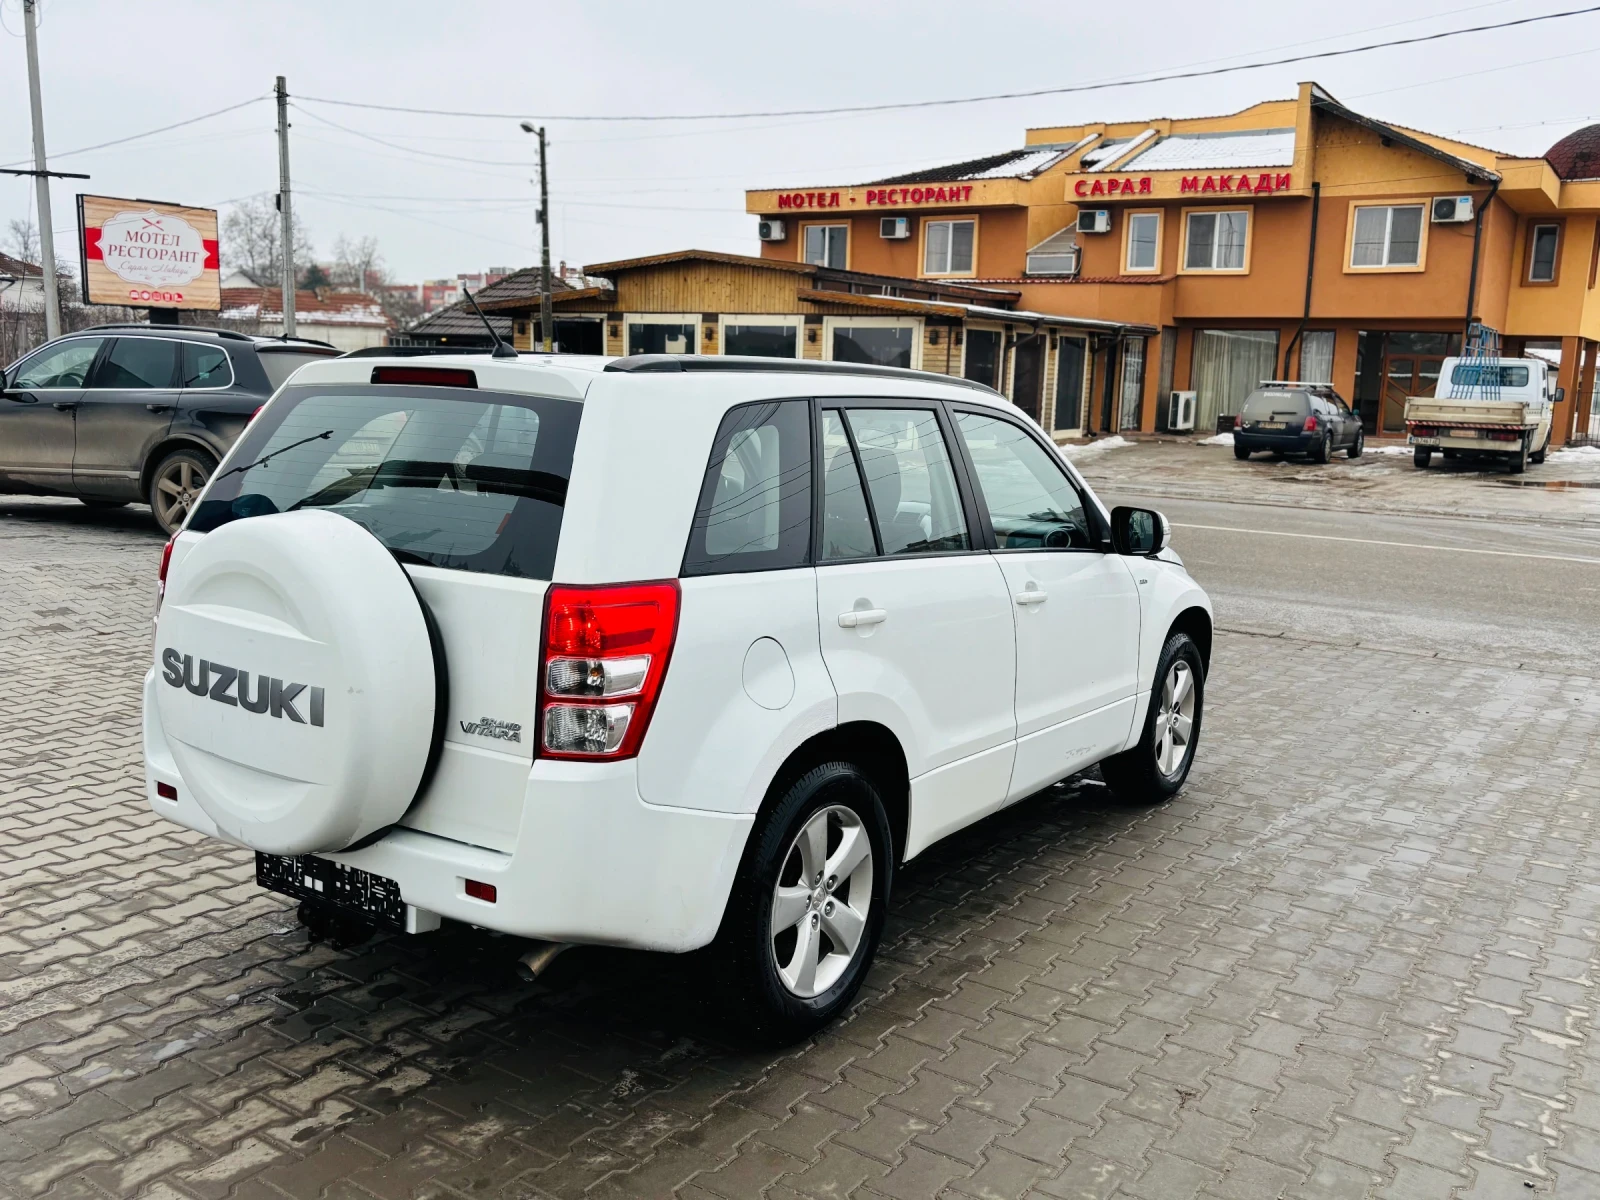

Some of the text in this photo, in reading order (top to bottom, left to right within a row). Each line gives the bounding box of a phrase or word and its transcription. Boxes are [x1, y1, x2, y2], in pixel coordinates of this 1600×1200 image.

[1074, 173, 1292, 197] САРАЯ МАКАДИ
[778, 192, 840, 209] МОТЕЛ
[866, 185, 973, 205] РЕСТОРАНТ
[125, 230, 180, 246] МОТЕЛ
[107, 245, 199, 263] РЕСТОРАНТ
[162, 647, 325, 728] SUZUKI
[460, 720, 522, 743] VITARA
[480, 716, 522, 731] GRAND
